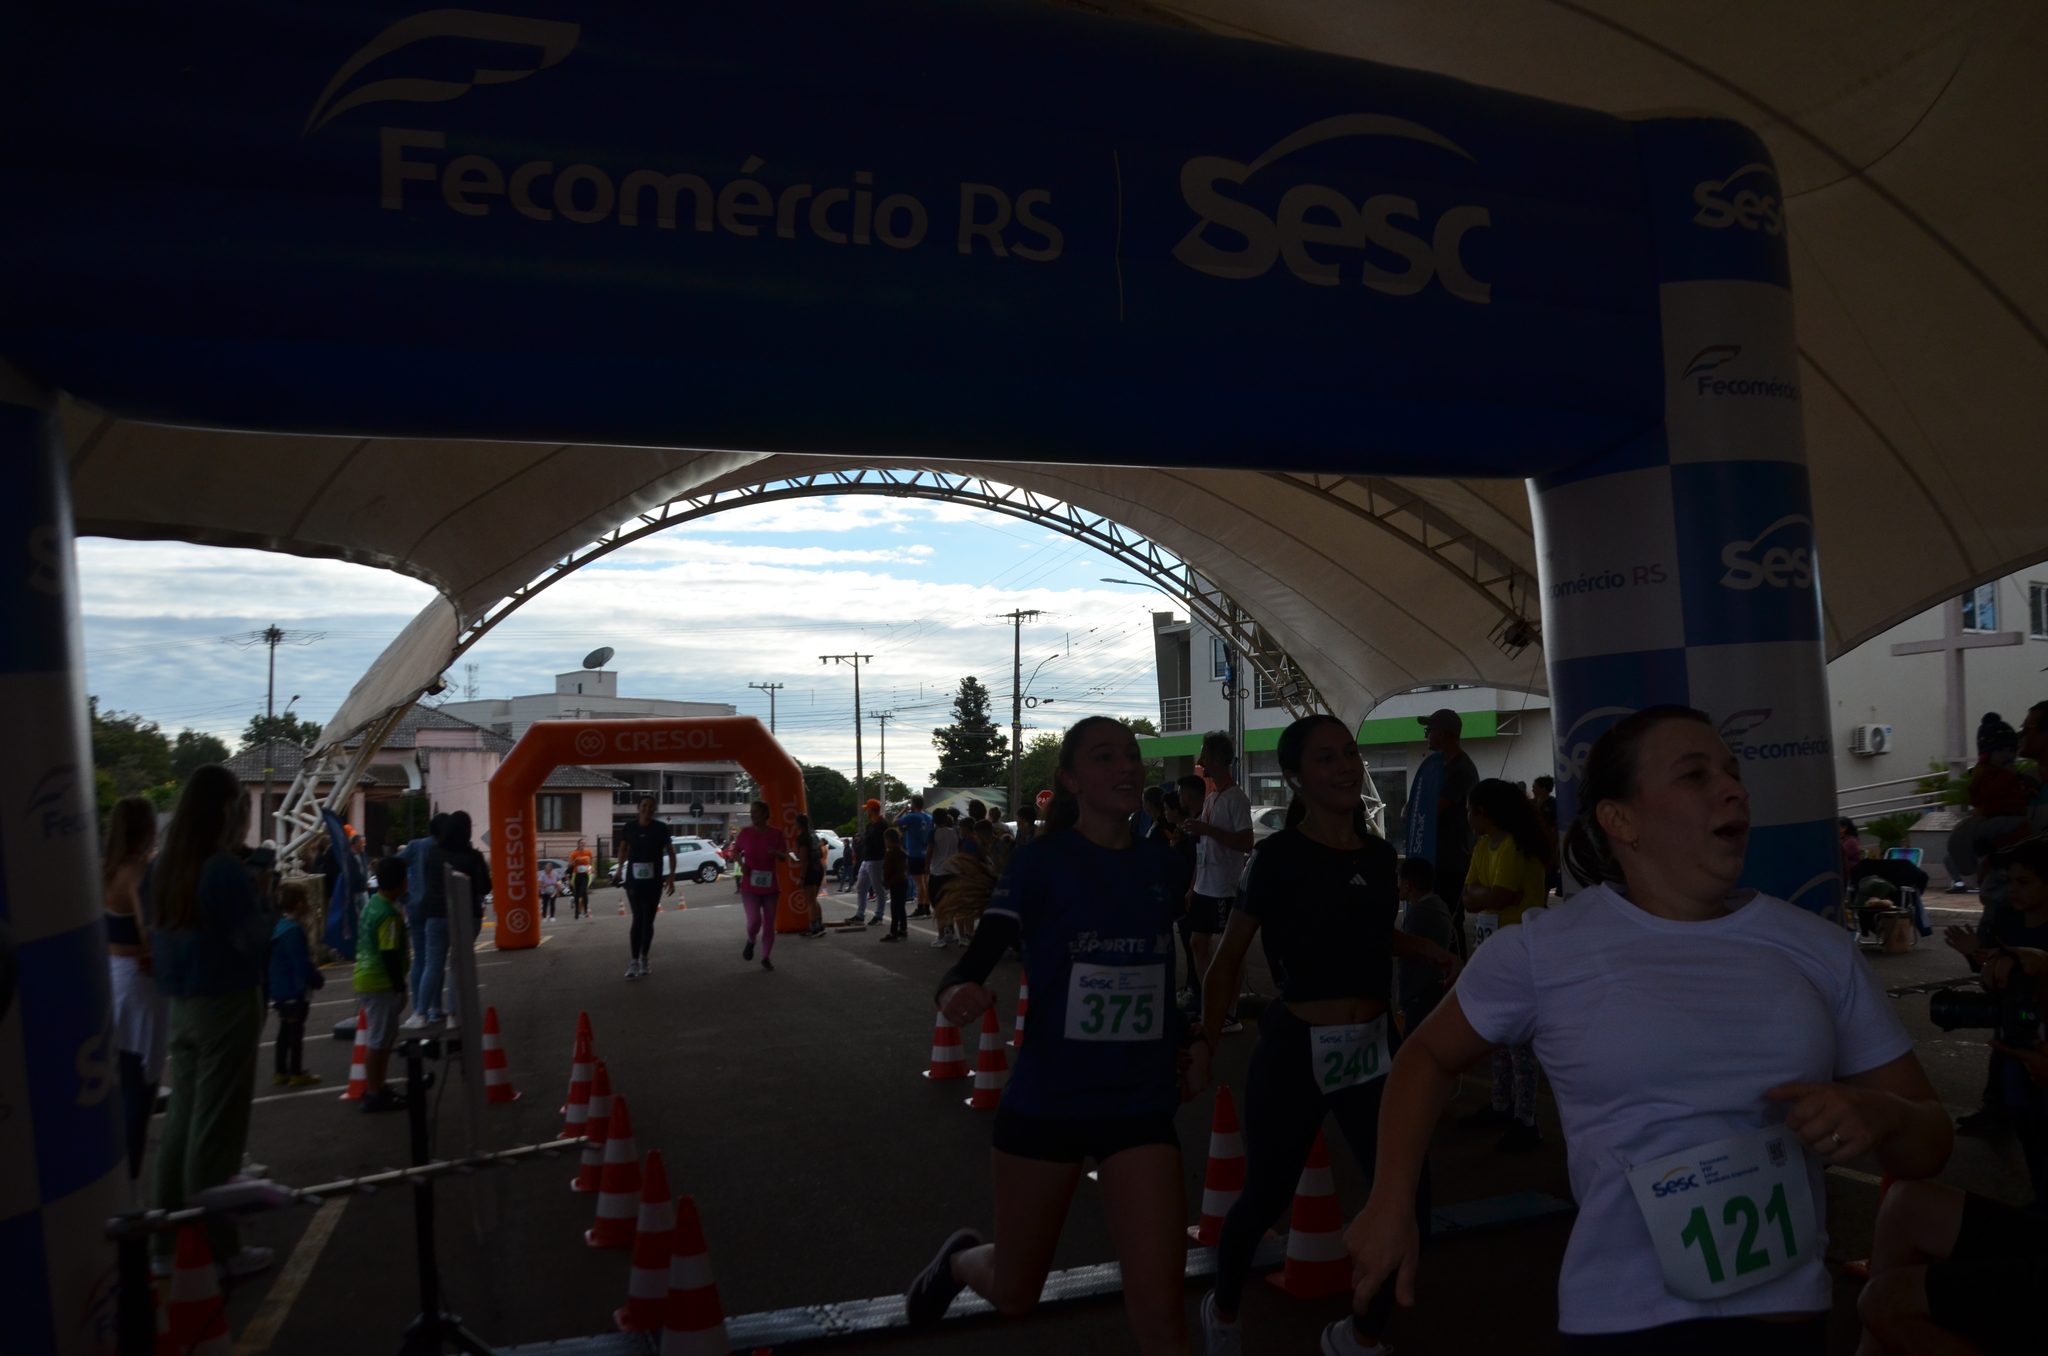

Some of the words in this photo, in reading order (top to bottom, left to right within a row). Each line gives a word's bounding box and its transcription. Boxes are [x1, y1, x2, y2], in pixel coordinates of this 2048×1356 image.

[380, 127, 928, 250] Fecomércio
[957, 181, 1064, 262] RS
[1171, 154, 1492, 304] Sesc
[1633, 563, 1668, 586] RS
[614, 728, 723, 752] CRESOL
[504, 810, 526, 901] CRESOL
[1079, 976, 1114, 990] Sesc
[1080, 993, 1154, 1035] 375
[1324, 1041, 1379, 1087] 240
[1652, 1174, 1699, 1198] Sesc
[1681, 1182, 1798, 1284] 121
